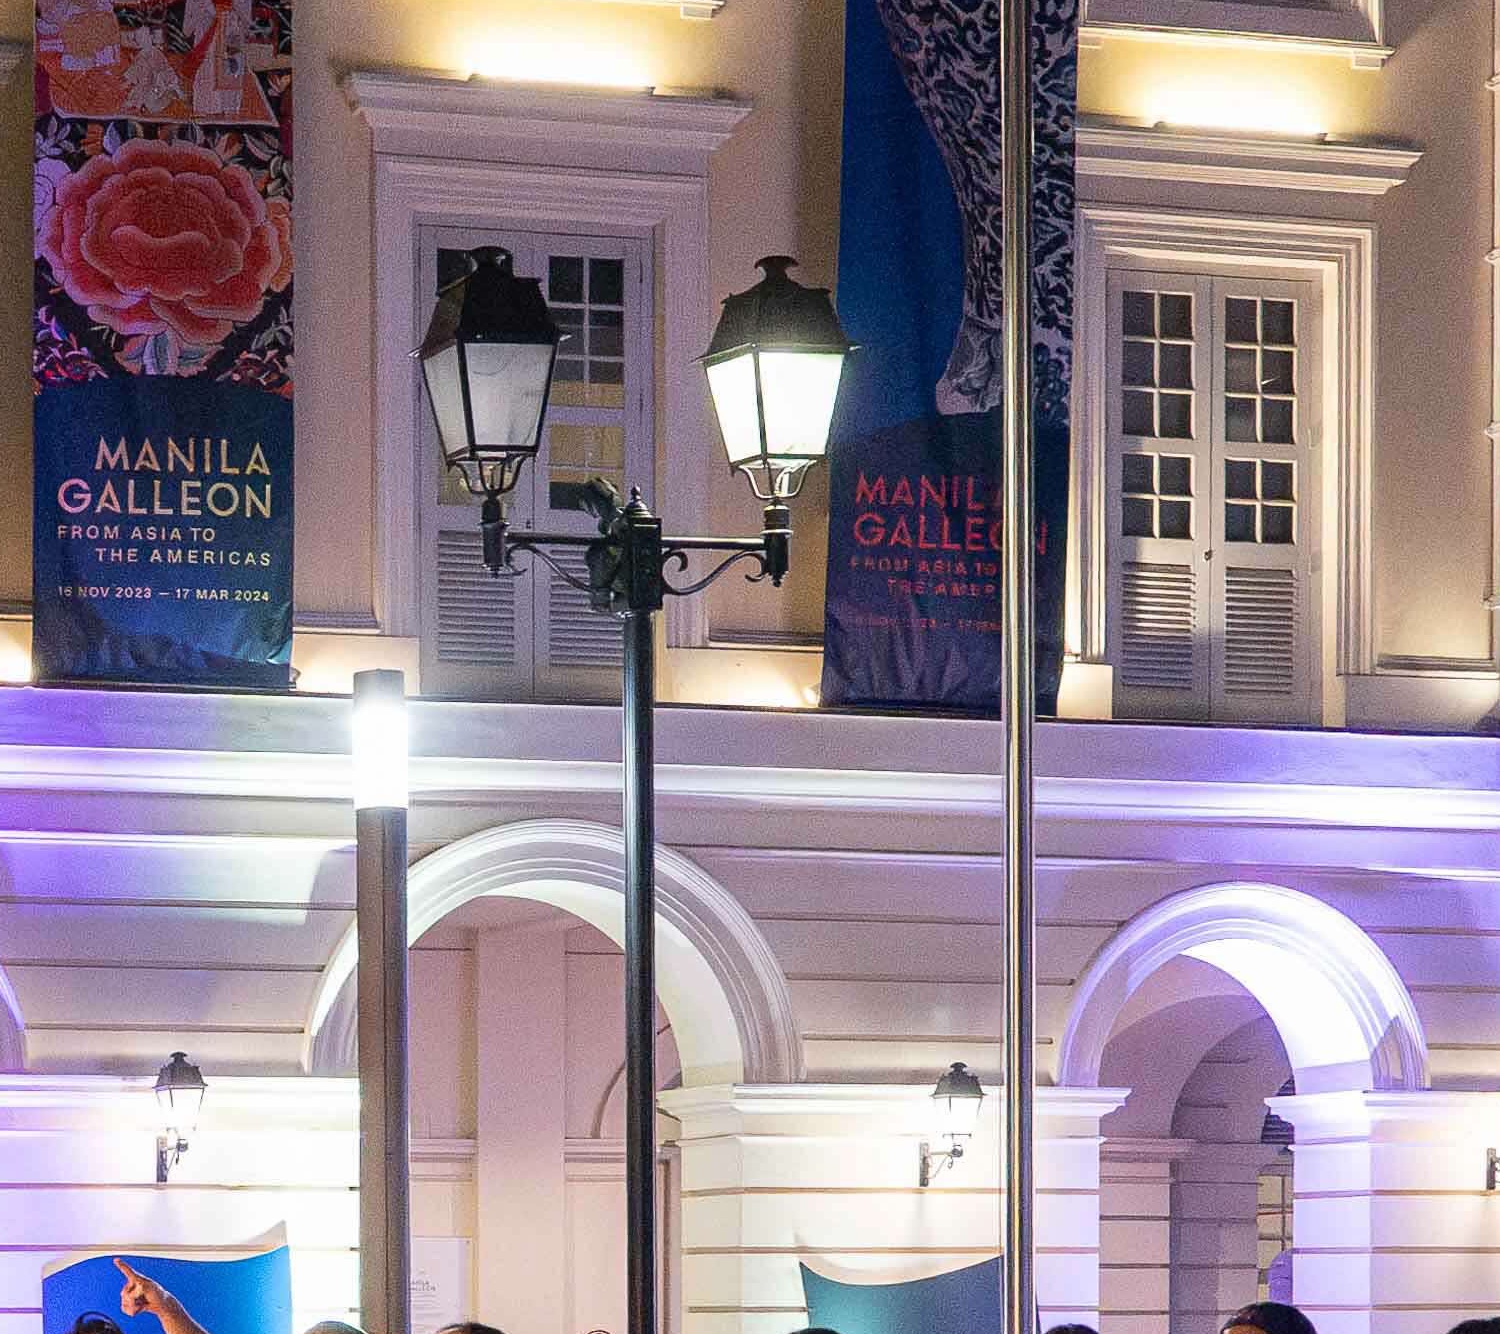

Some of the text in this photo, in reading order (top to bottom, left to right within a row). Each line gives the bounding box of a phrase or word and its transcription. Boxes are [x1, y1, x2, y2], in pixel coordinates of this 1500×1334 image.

[94, 436, 271, 476] MANILA
[57, 478, 272, 519] GALLEON
[57, 524, 217, 543] FROM ASIA TO
[95, 547, 271, 567] THE AMERICAS
[77, 585, 110, 599] NOV
[114, 586, 152, 600] 2023
[175, 587, 190, 600] 17
[195, 588, 229, 601] MAR
[233, 589, 270, 602] 2024
[934, 581, 997, 598] AMER
